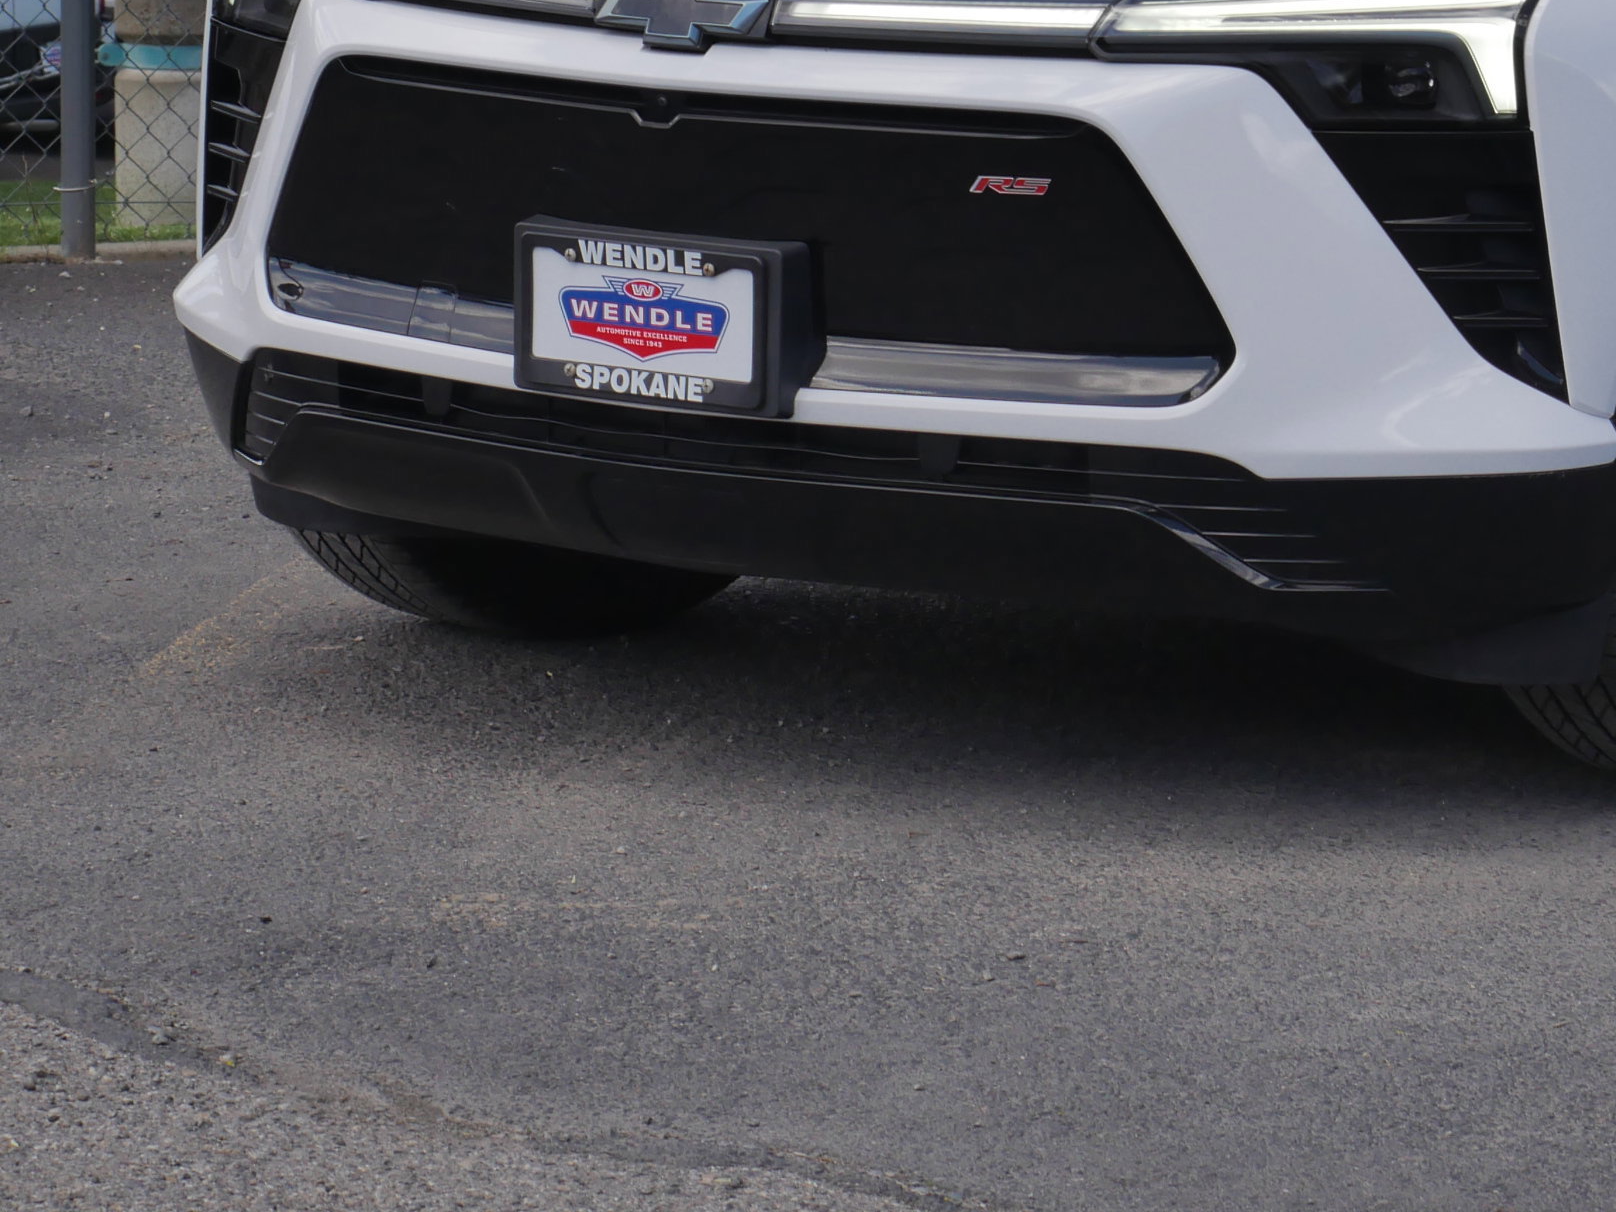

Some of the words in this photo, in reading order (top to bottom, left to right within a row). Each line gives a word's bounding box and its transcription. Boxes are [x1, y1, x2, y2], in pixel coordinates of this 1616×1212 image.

[969, 175, 1052, 196] RS
[578, 239, 703, 277] WENDLE
[570, 298, 713, 332] WENDLE
[596, 326, 641, 337] AUTOMOTIVE
[643, 331, 688, 342] EXCELLENCE
[623, 337, 644, 346] SINCE
[646, 340, 662, 348] 1943
[574, 363, 704, 403] SPOKANE
